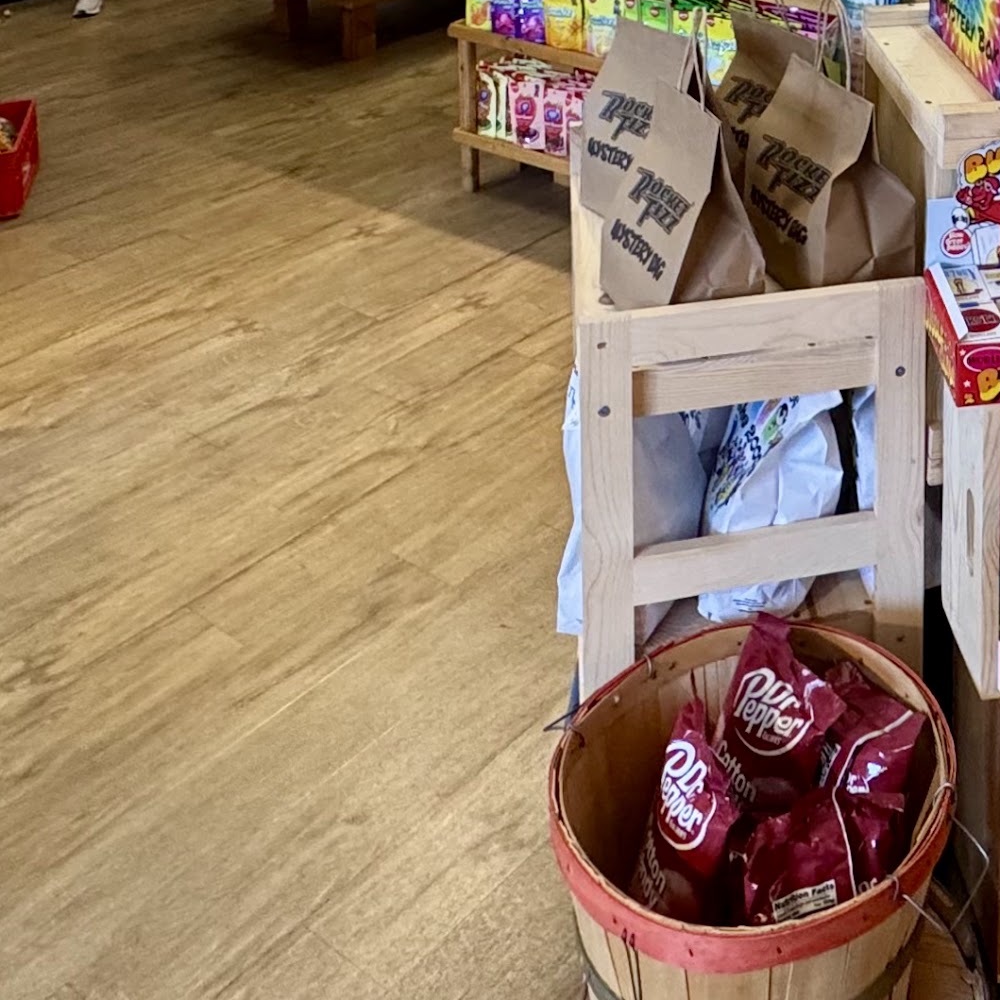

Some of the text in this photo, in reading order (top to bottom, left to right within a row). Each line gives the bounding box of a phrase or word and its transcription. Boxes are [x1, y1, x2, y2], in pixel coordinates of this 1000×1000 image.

[628, 166, 691, 218] ROCKET
[637, 197, 680, 235] FIZZ
[734, 680, 803, 738] Pepper
[661, 758, 704, 831] Pepper
[714, 740, 757, 802] Cotton
[774, 883, 835, 910] Nutrition Facts
